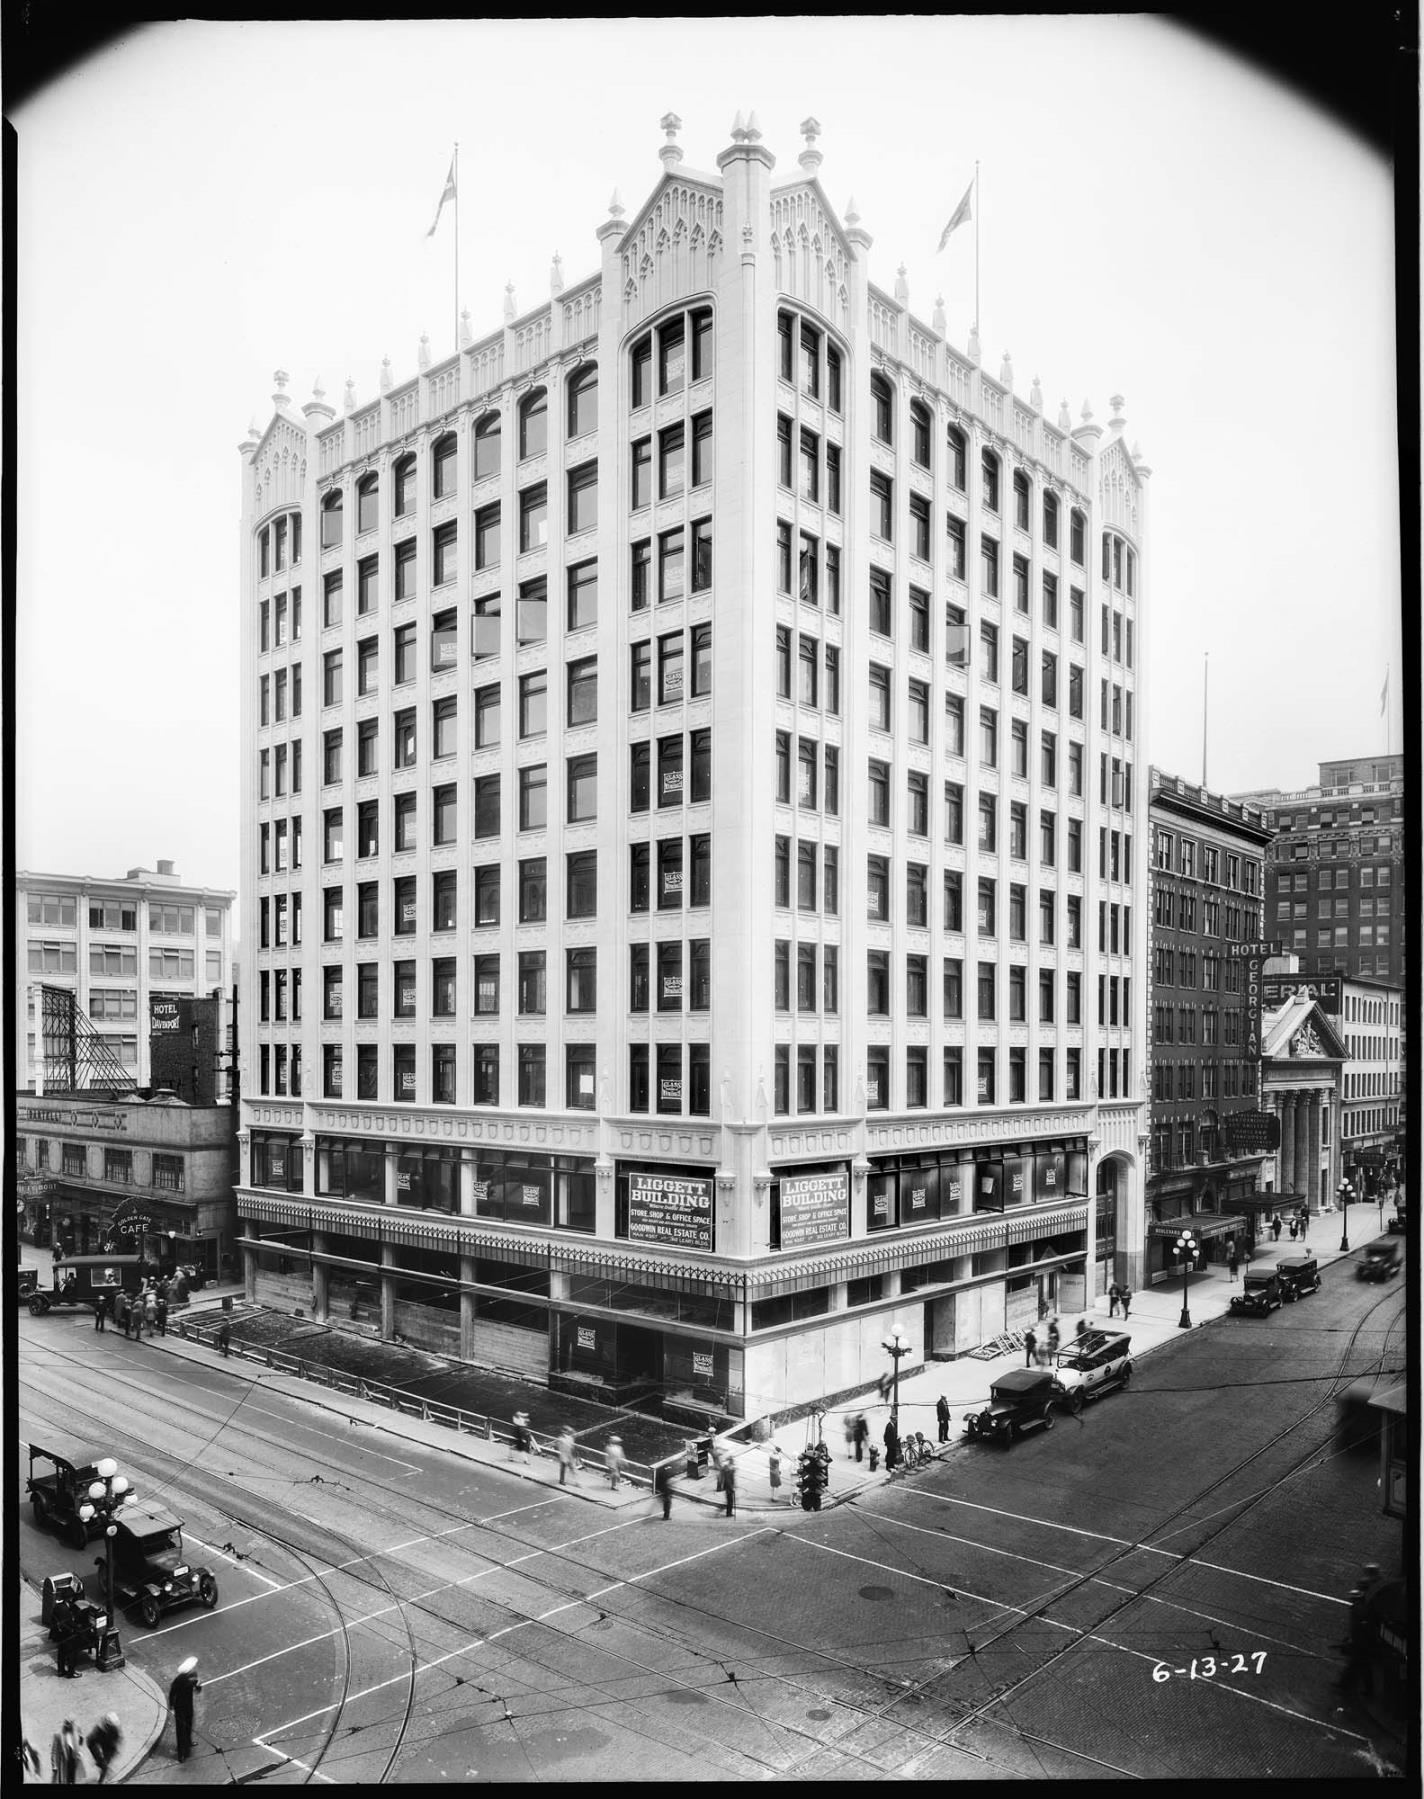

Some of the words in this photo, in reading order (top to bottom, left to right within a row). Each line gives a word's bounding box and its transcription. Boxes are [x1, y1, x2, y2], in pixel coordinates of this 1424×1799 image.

[1231, 943, 1278, 956] HOTEL
[154, 1004, 178, 1014] HOTEL
[1247, 959, 1260, 1055] GEORGIAN
[637, 1177, 706, 1195] LIGGETT
[785, 1177, 844, 1194] LIGGETT
[631, 1190, 710, 1208] BUILDING
[782, 1189, 846, 1208] BUILDING
[117, 1215, 138, 1227] GOLDEN
[138, 1214, 152, 1224] GATE
[649, 1211, 664, 1219] SHOP
[672, 1213, 692, 1223] OFFICE
[692, 1216, 711, 1225] SPACE
[817, 1210, 833, 1218] OFFICE
[120, 1223, 149, 1235] CAFE
[630, 1223, 656, 1234] GOODWIN
[657, 1226, 672, 1236] REAL
[674, 1228, 697, 1239] ESTATE
[699, 1232, 710, 1241] CO.
[806, 1226, 818, 1235] REAL
[819, 1223, 837, 1233] ESTATE
[1152, 1651, 1268, 1682] 6-13-27
